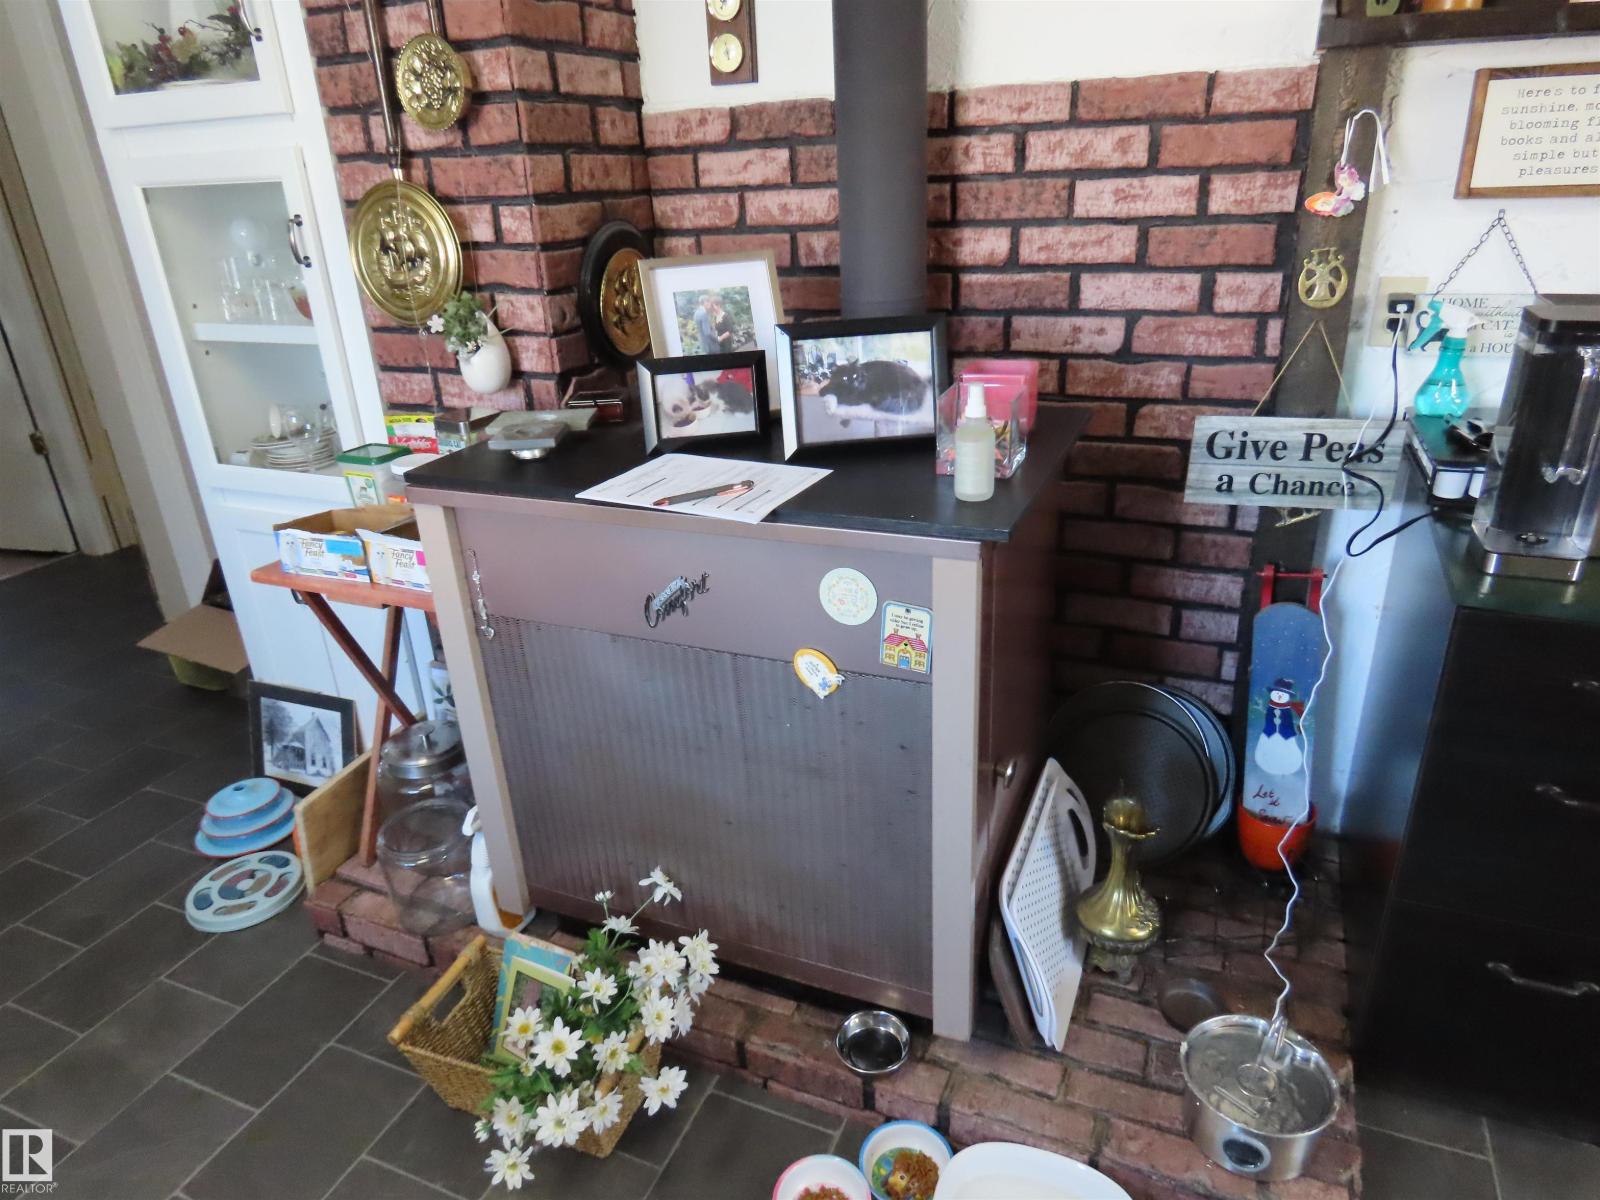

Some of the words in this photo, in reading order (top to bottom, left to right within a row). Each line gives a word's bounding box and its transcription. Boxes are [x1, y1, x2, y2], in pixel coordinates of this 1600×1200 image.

[1570, 85, 1587, 96] to
[1509, 118, 1580, 131] blooming
[1500, 134, 1544, 146] books
[1549, 133, 1578, 144] and
[1513, 150, 1565, 162] simple
[1572, 148, 1598, 159] but
[1205, 429, 1288, 461] Give
[1299, 432, 1385, 464] Peas
[1215, 473, 1234, 494] a
[1249, 472, 1355, 497] Chance
[1252, 784, 1275, 798] Let
